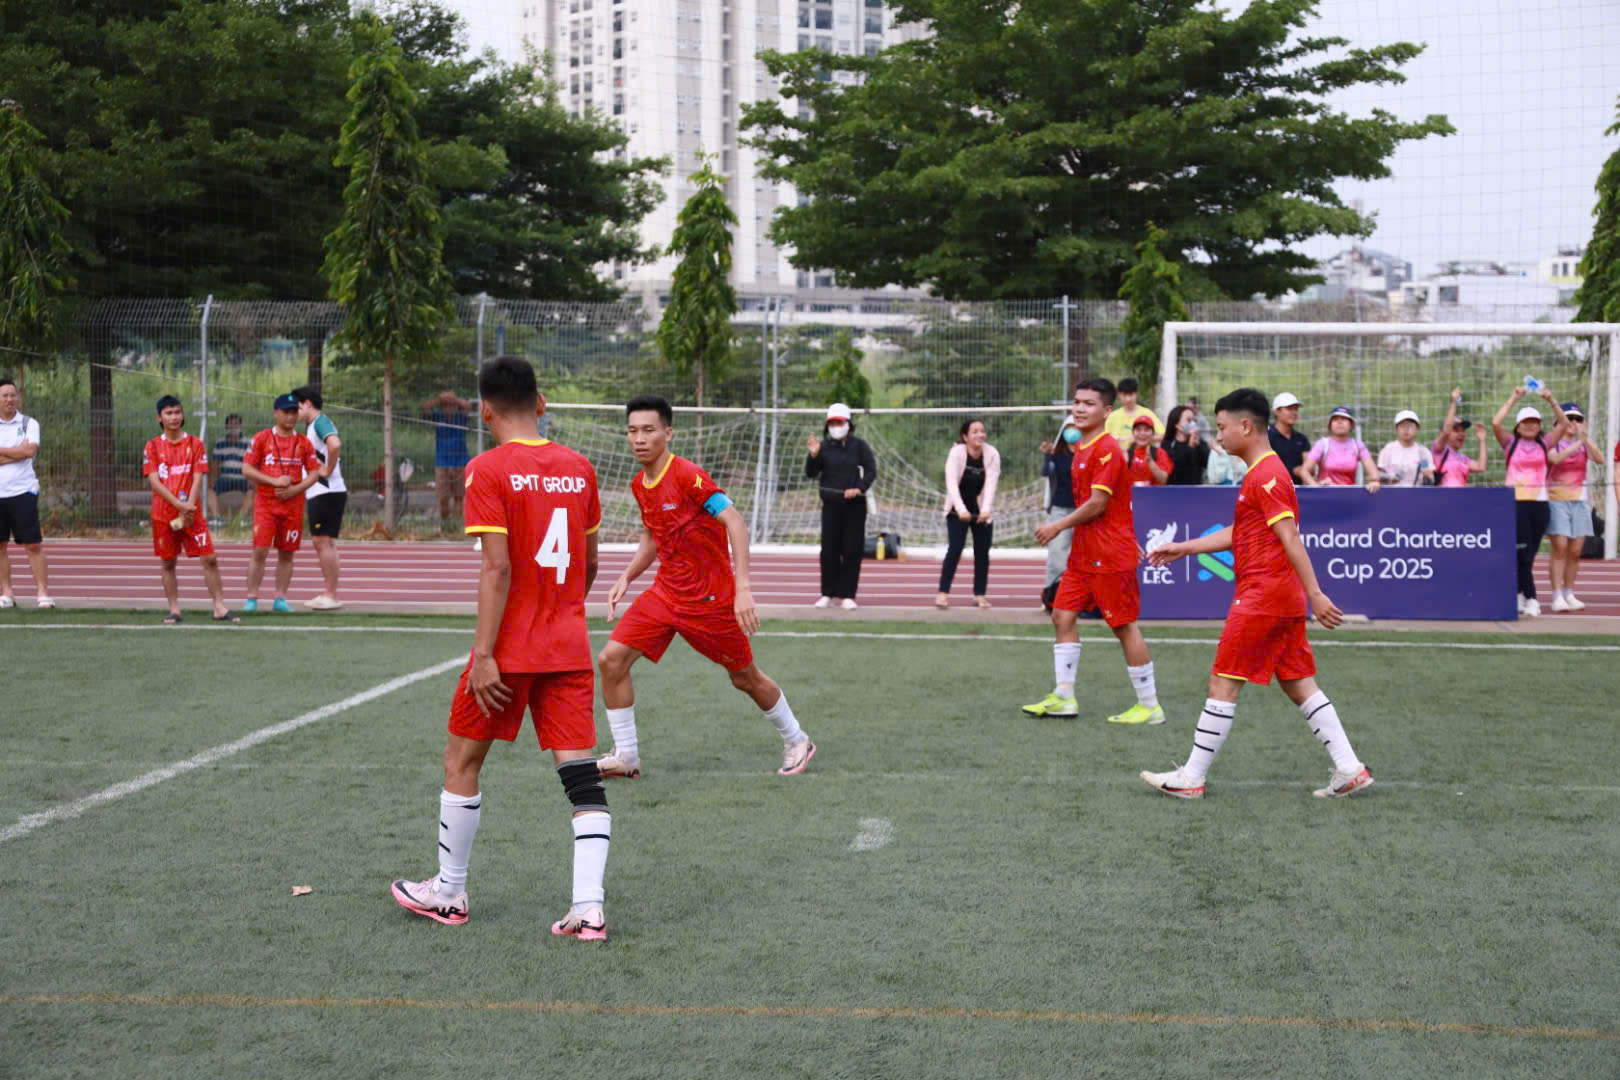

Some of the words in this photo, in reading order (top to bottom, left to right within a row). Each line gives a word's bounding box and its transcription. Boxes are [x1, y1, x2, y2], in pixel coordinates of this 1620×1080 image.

[510, 474, 539, 491] BMT
[543, 476, 586, 493] GROUP
[286, 530, 299, 543] 19
[534, 507, 571, 584] 4
[1299, 528, 1372, 548] ndard
[1378, 527, 1491, 549] Chartered
[1327, 558, 1374, 584] Cup
[1379, 558, 1434, 579] 2025
